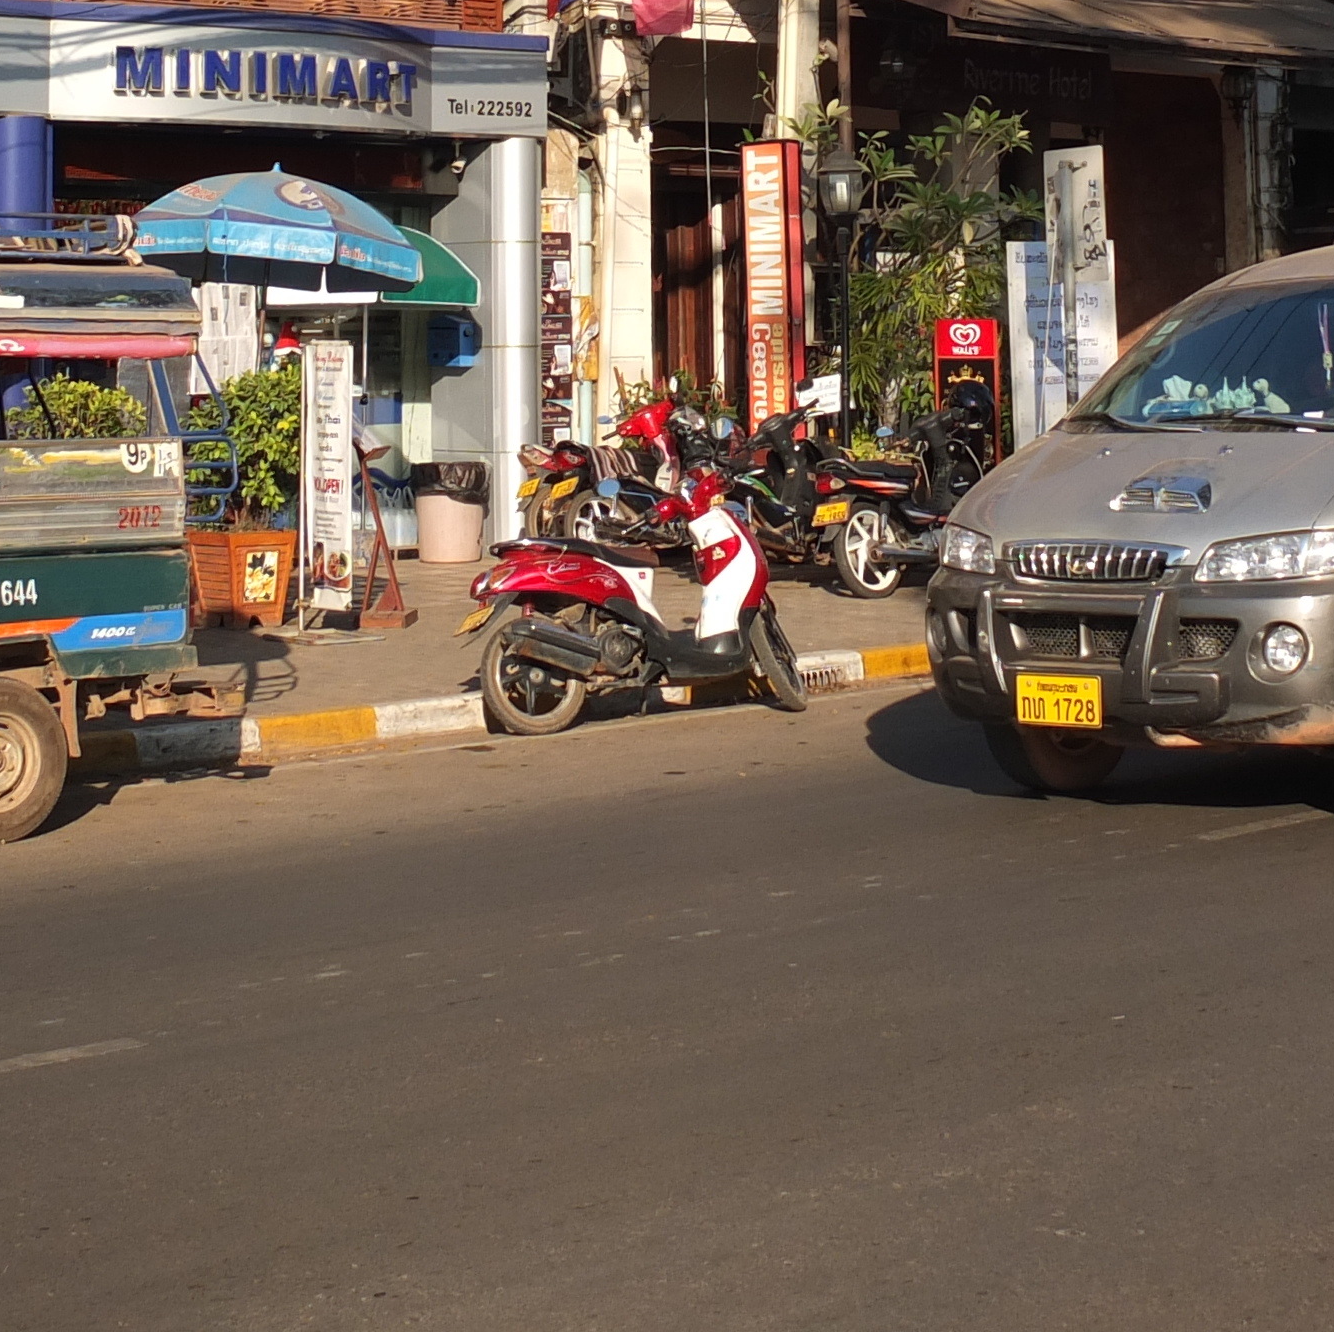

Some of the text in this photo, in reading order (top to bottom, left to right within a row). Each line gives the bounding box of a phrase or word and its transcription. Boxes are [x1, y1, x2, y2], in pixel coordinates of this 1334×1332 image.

[115, 45, 418, 108] MINIMART
[746, 149, 784, 316] MINIMART
[118, 505, 161, 529] 2012
[1053, 697, 1096, 723] 1728
